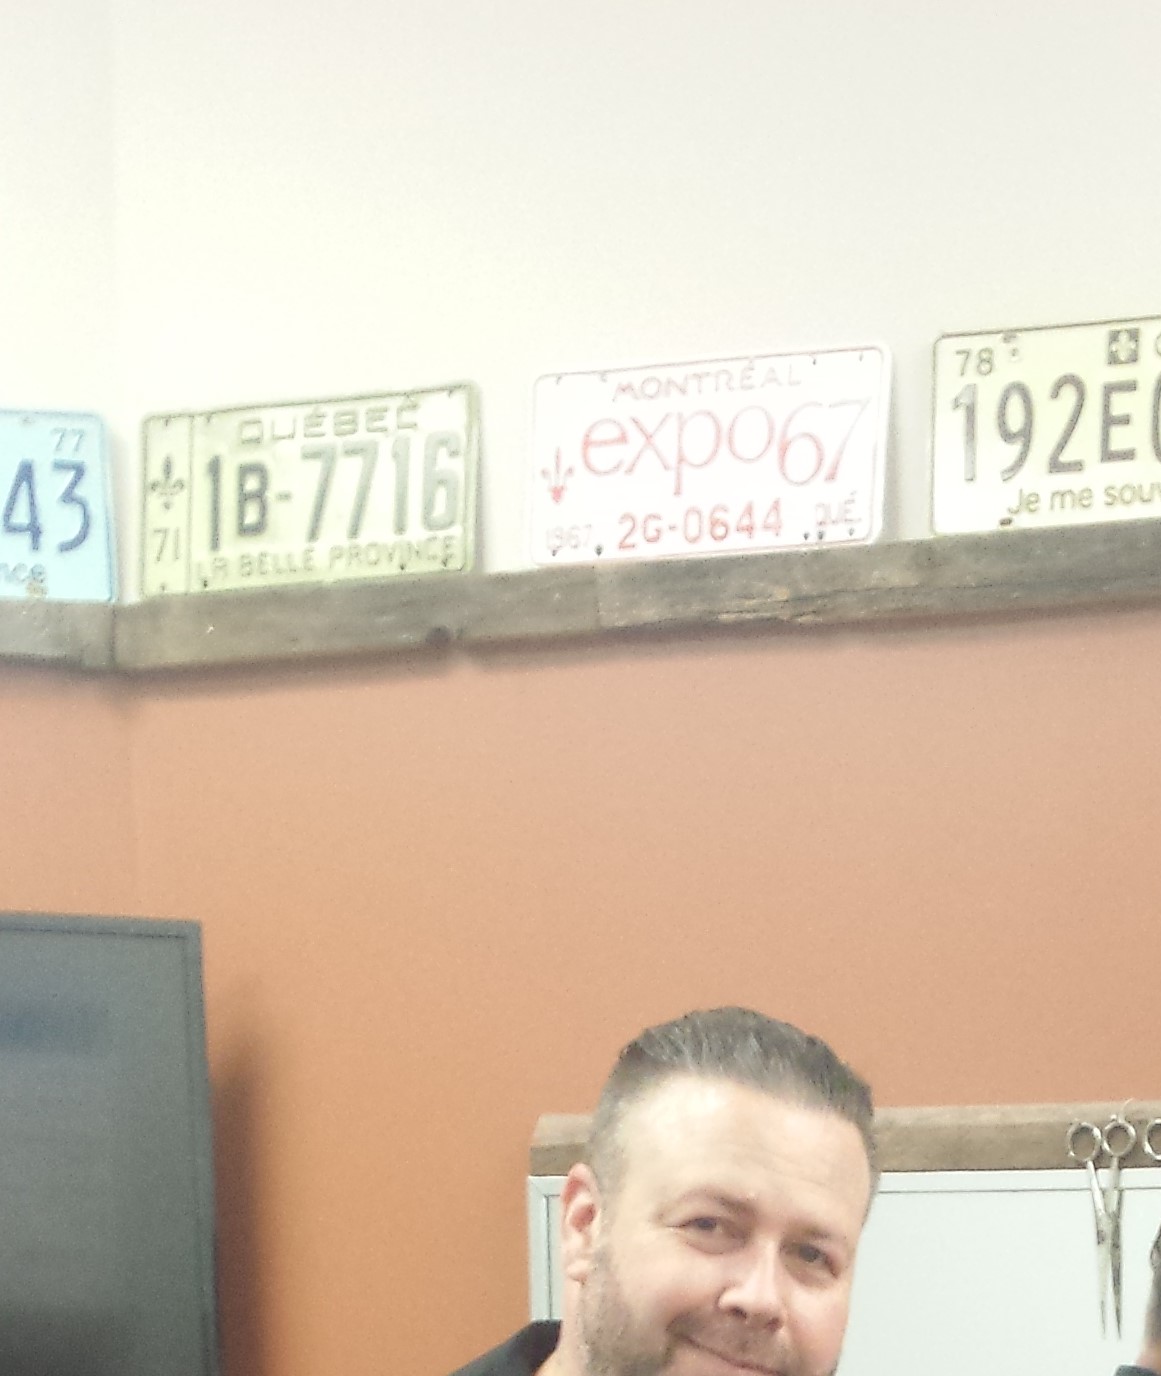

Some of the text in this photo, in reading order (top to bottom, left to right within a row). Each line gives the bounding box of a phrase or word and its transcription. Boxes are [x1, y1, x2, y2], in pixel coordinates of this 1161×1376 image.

[954, 347, 994, 377] 78
[51, 427, 86, 452] 77
[237, 402, 419, 447] QUÉBEC
[2, 458, 91, 552] 43
[206, 430, 463, 552] 1B-7716
[1007, 488, 1041, 517] Je
[1049, 484, 1093, 511] me
[152, 527, 182, 564] 71
[617, 497, 783, 551] 2G-0644
[239, 546, 316, 578] BELLE
[328, 533, 458, 570] PROVINCE
